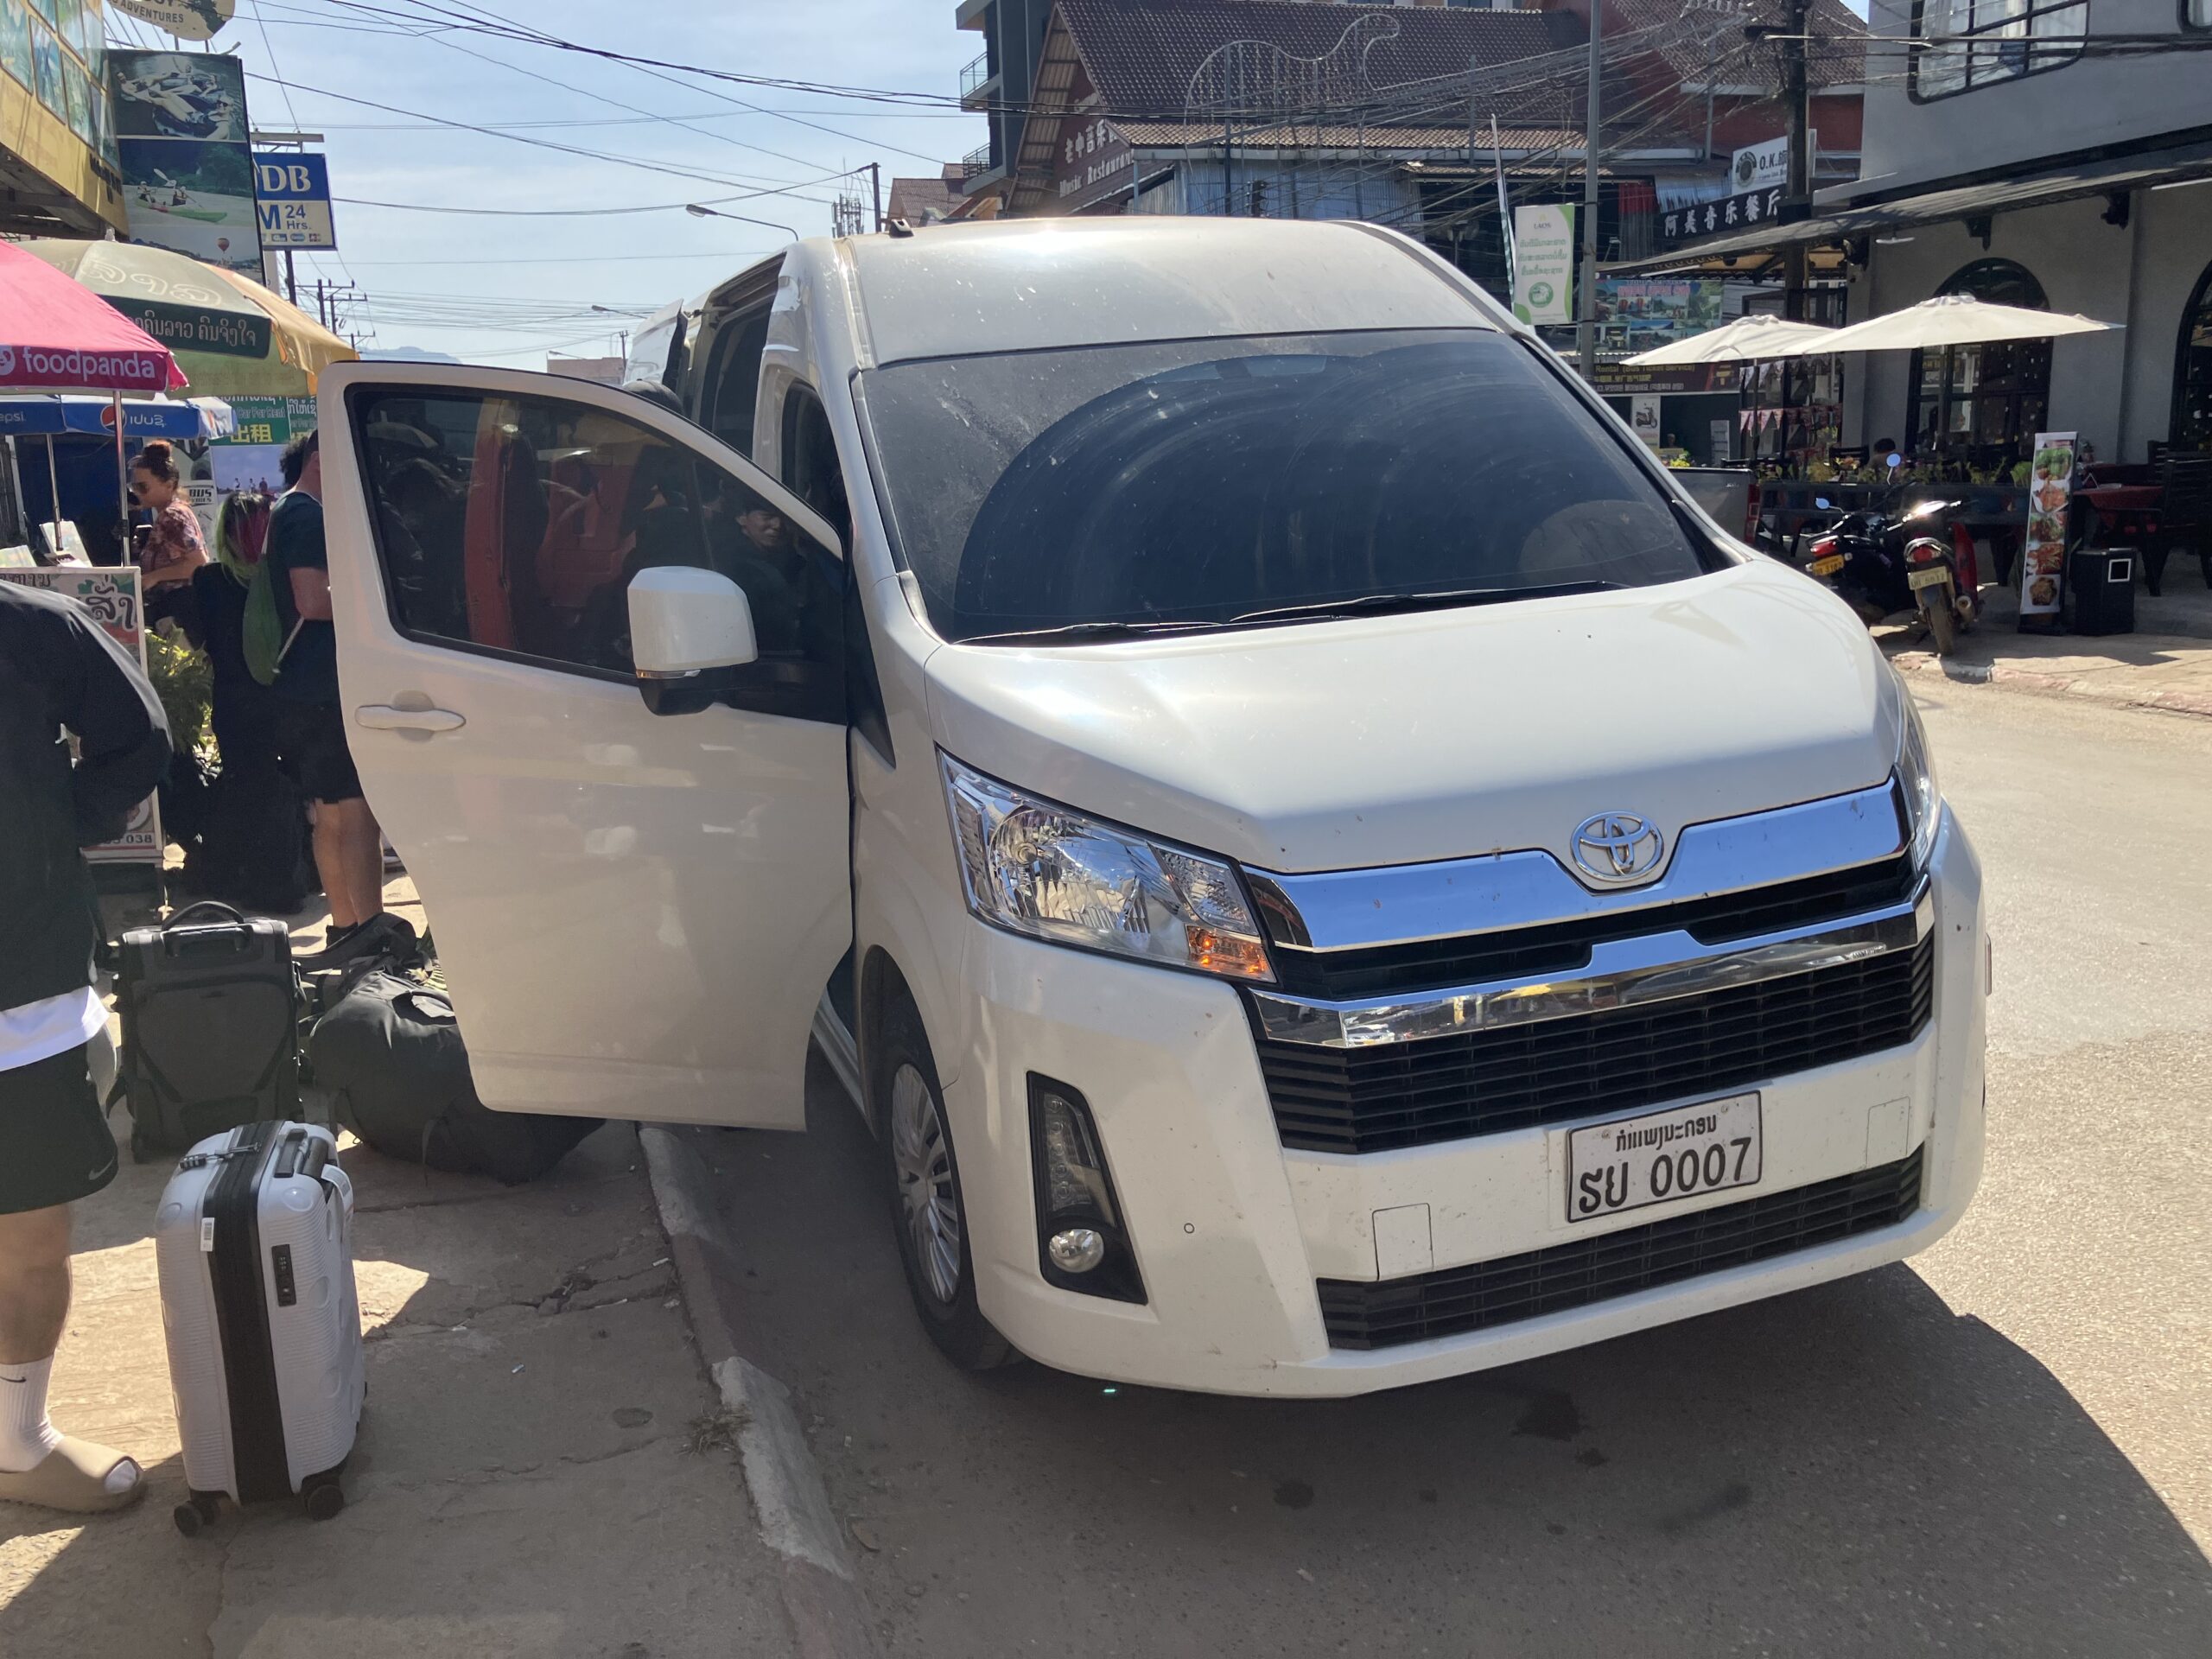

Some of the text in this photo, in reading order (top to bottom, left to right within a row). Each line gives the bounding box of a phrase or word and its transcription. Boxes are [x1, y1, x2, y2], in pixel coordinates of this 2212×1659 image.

[121, 1, 184, 23] ADVENTURES
[284, 204, 306, 219] 24
[286, 219, 312, 231] Hrs.
[22, 346, 156, 382] foodpanda
[0, 410, 24, 424] epsi
[230, 423, 273, 443] 出租
[125, 834, 152, 844] 038
[1650, 1136, 1751, 1198] 0007
